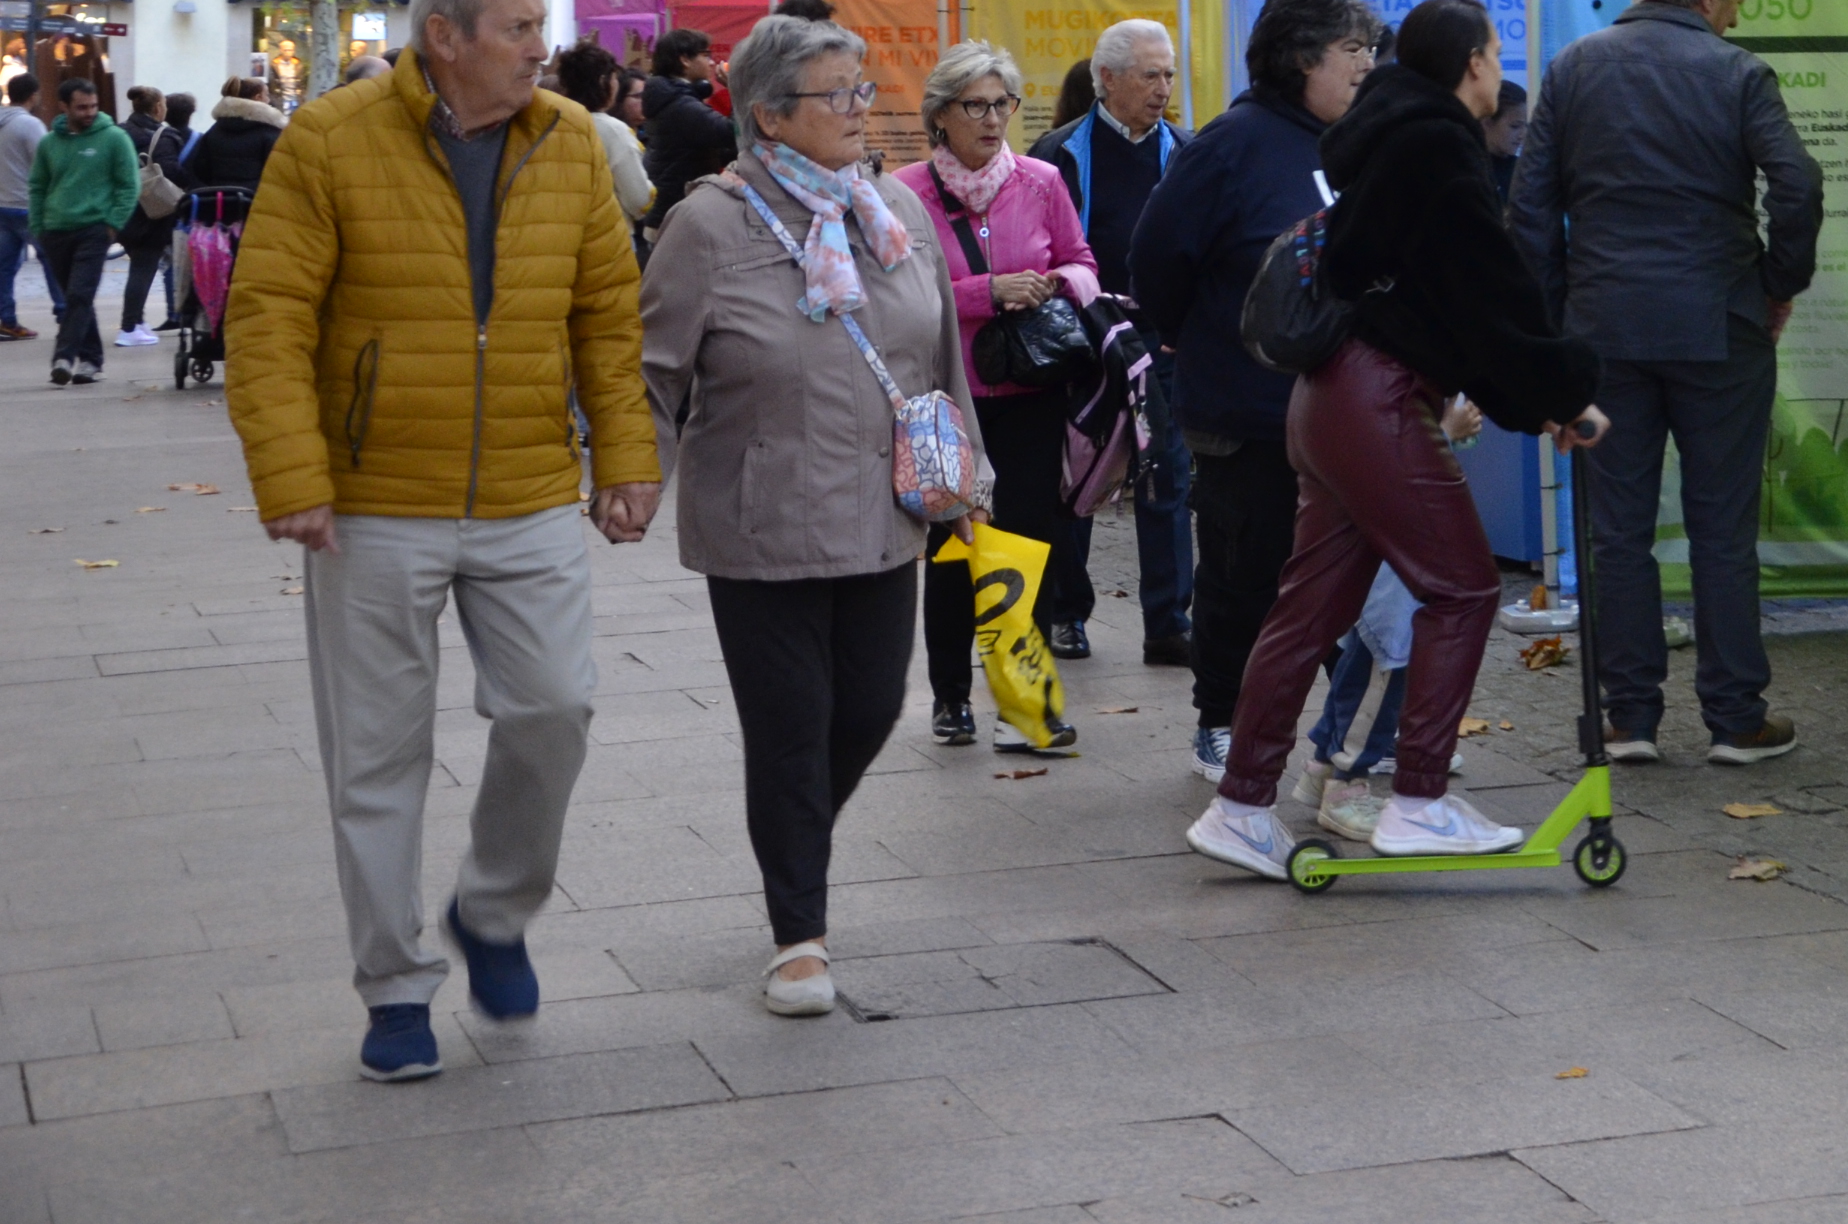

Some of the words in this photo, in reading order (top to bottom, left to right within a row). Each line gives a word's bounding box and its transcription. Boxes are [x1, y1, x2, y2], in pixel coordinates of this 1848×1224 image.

[899, 26, 939, 43] ETX
[1025, 36, 1094, 58] MOVI
[1775, 70, 1827, 88] KADI
[1787, 109, 1819, 119] eneko
[1820, 108, 1844, 118] hasi
